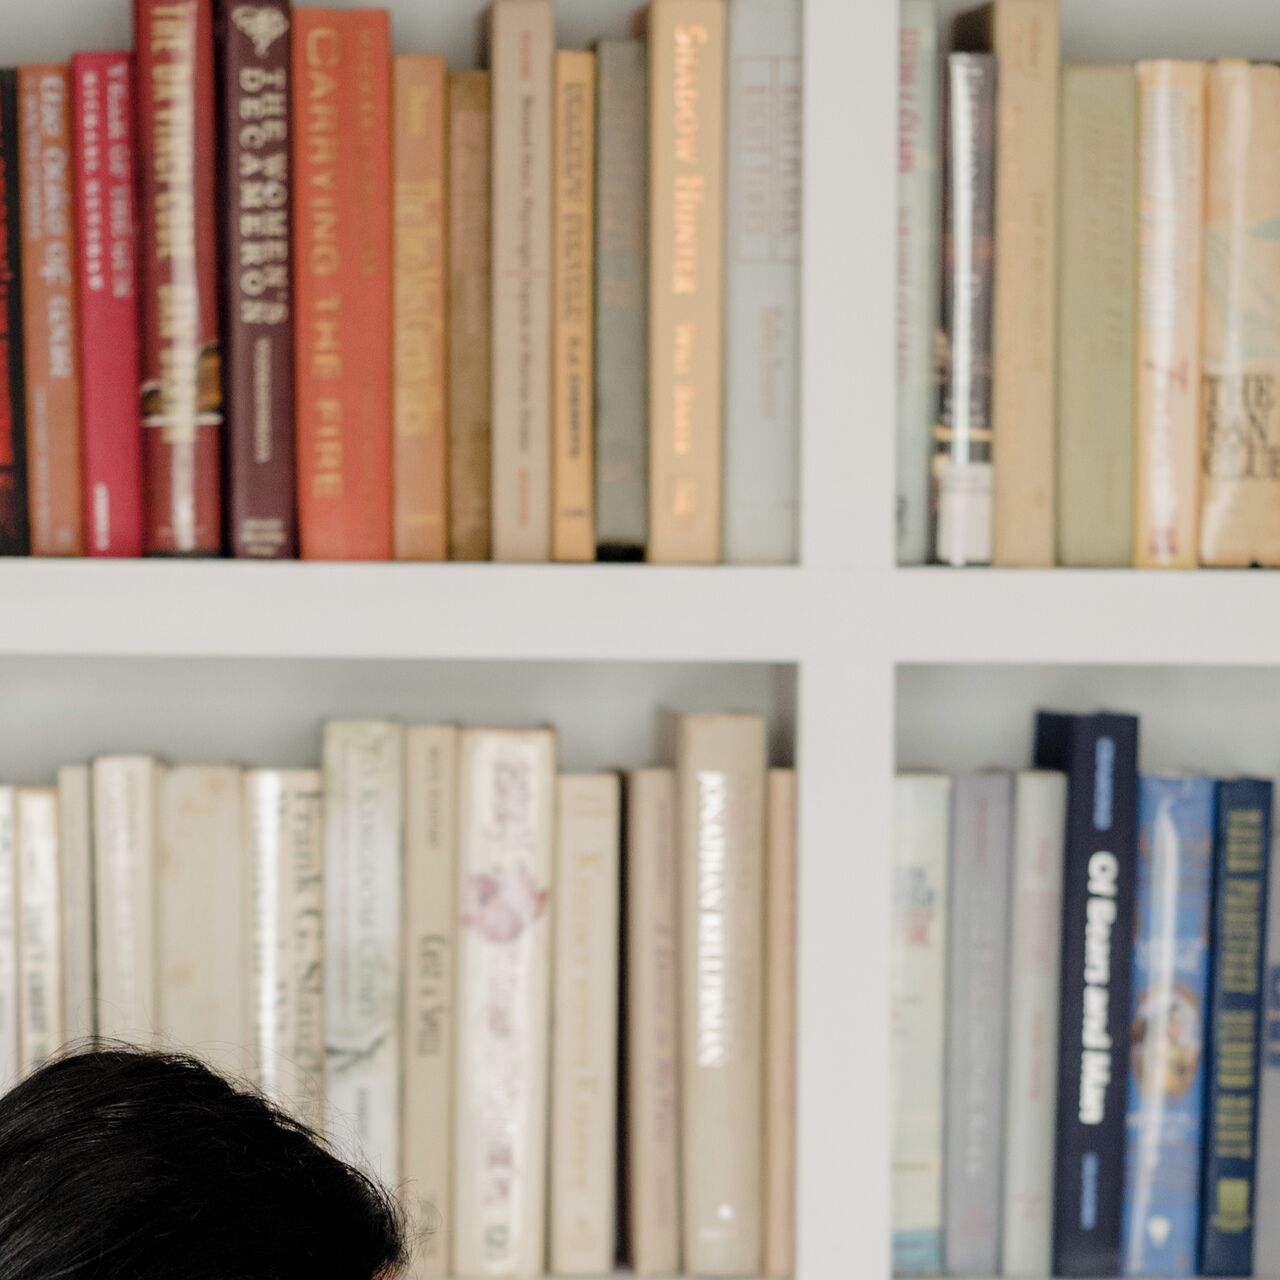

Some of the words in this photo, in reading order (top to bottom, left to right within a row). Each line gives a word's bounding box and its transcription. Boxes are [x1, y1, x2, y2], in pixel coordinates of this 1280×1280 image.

[151, 3, 193, 52] THE
[263, 67, 288, 129] THE
[673, 24, 709, 163] SHADOW
[239, 67, 265, 326] DECAMERON
[306, 27, 344, 278] CARRYING
[262, 152, 289, 326] WOMEN'S
[673, 174, 705, 295] HUNTER
[310, 293, 343, 378] THE
[311, 399, 344, 501] FIRE
[696, 772, 729, 909] JONATHAN
[1087, 851, 1119, 895] Of
[696, 911, 729, 1068] KELLERMAN
[1084, 899, 1117, 984] Bears
[1082, 986, 1111, 1049] and
[1078, 1051, 1110, 1124] Man
